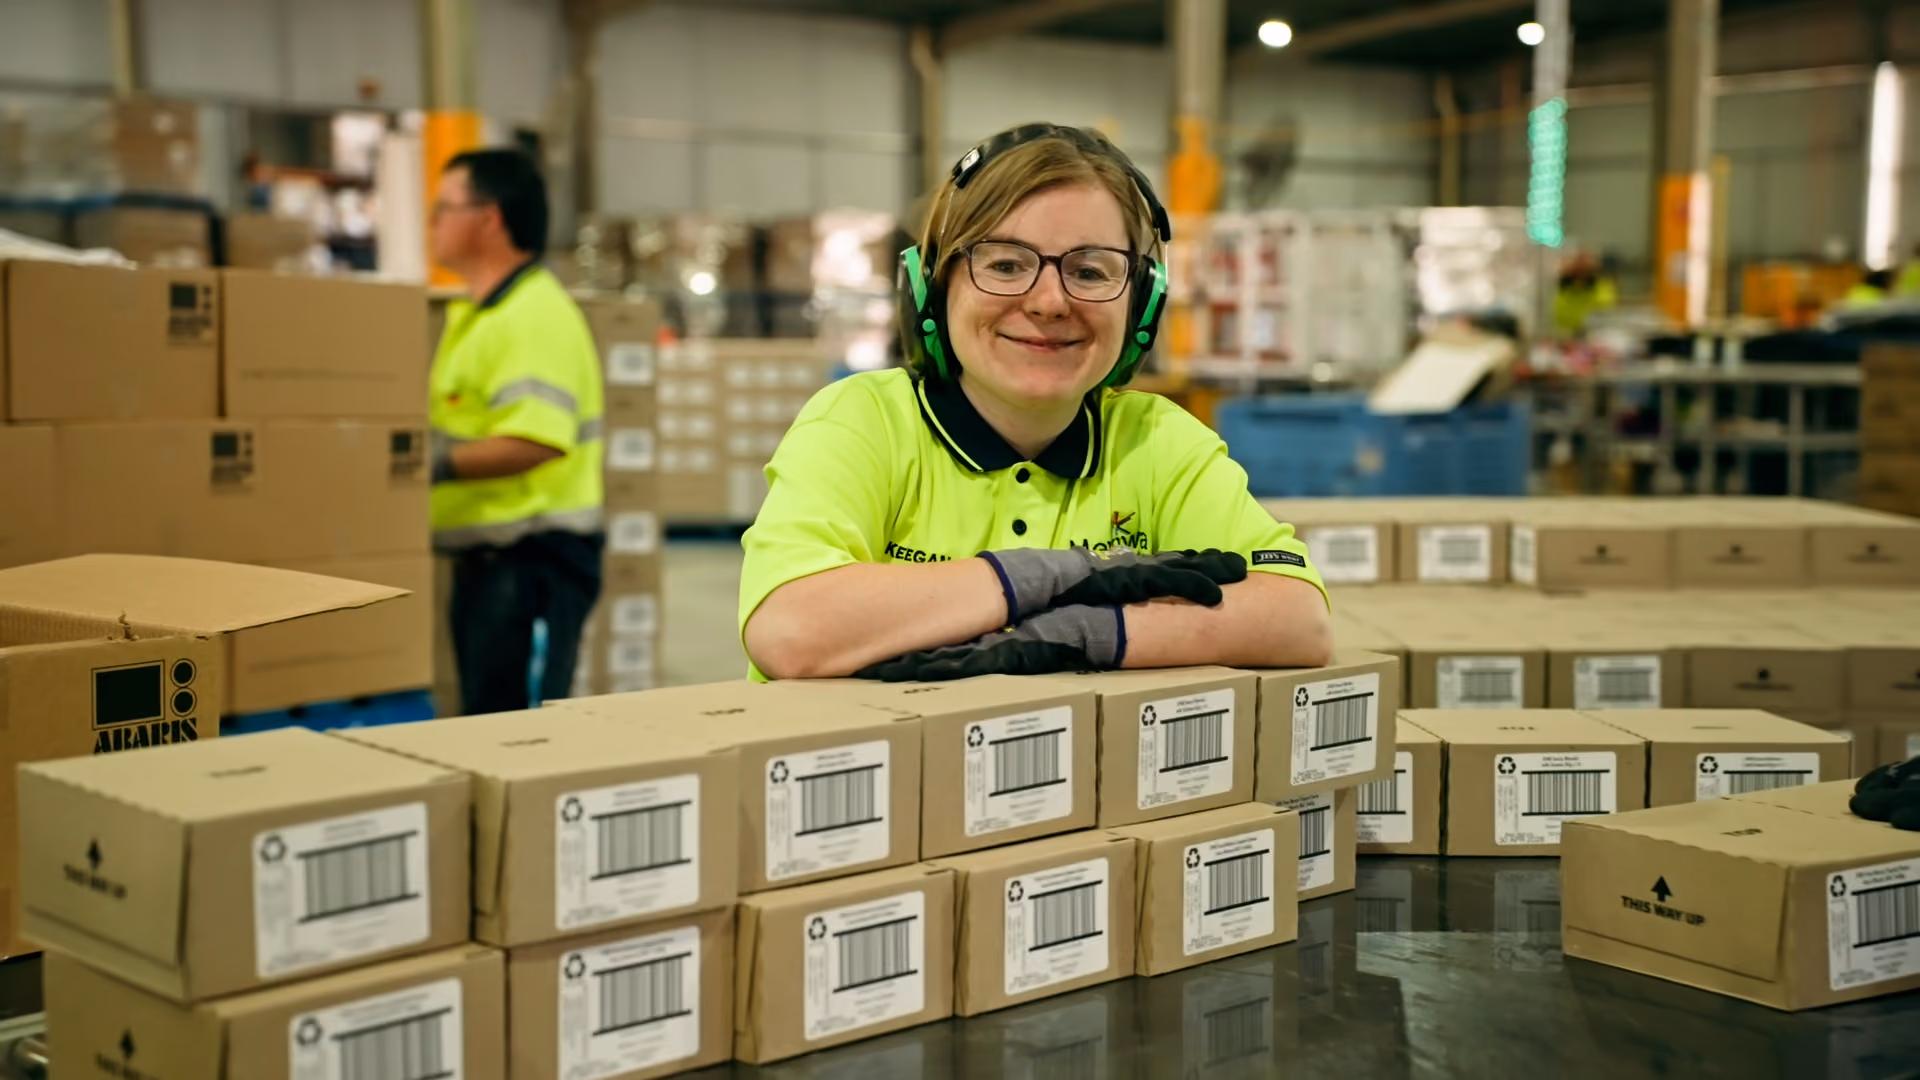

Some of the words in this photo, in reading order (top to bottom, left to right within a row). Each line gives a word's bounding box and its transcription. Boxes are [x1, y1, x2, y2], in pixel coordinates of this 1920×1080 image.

[94, 717, 198, 754] ABARIS
[1620, 895, 1651, 914] THIS
[1653, 903, 1683, 921] WAY
[1685, 911, 1706, 926] UP
